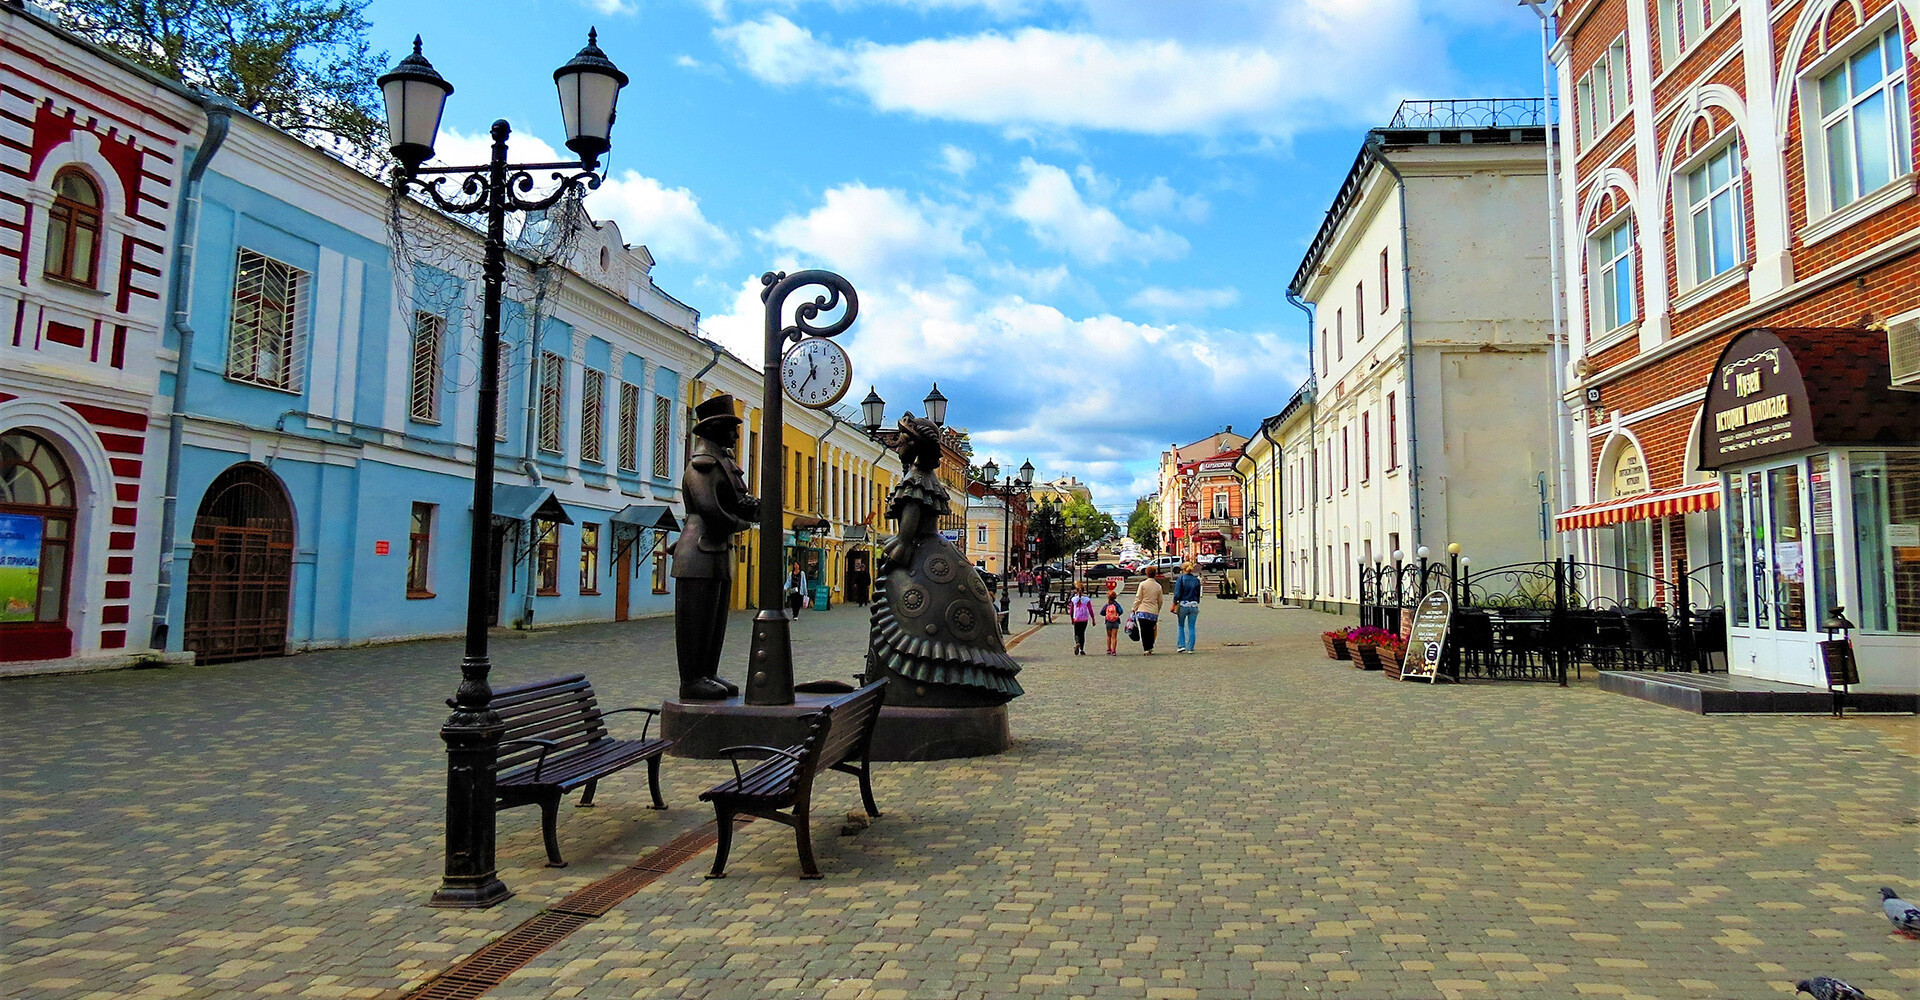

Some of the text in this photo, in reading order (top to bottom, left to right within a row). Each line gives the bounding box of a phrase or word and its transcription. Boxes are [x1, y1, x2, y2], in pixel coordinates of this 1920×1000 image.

[809, 344, 818, 353] 12
[830, 356, 836, 364] 2
[788, 369, 794, 377] 9
[833, 367, 839, 376] 3
[791, 380, 797, 388] 8
[830, 379, 836, 387] 4
[1735, 367, 1761, 397] Музей
[810, 391, 816, 399] 6
[822, 388, 828, 396] 5
[1715, 405, 1745, 432] истории
[1746, 393, 1788, 424] шоколада
[7, 557, 37, 566] ПРИРОДА
